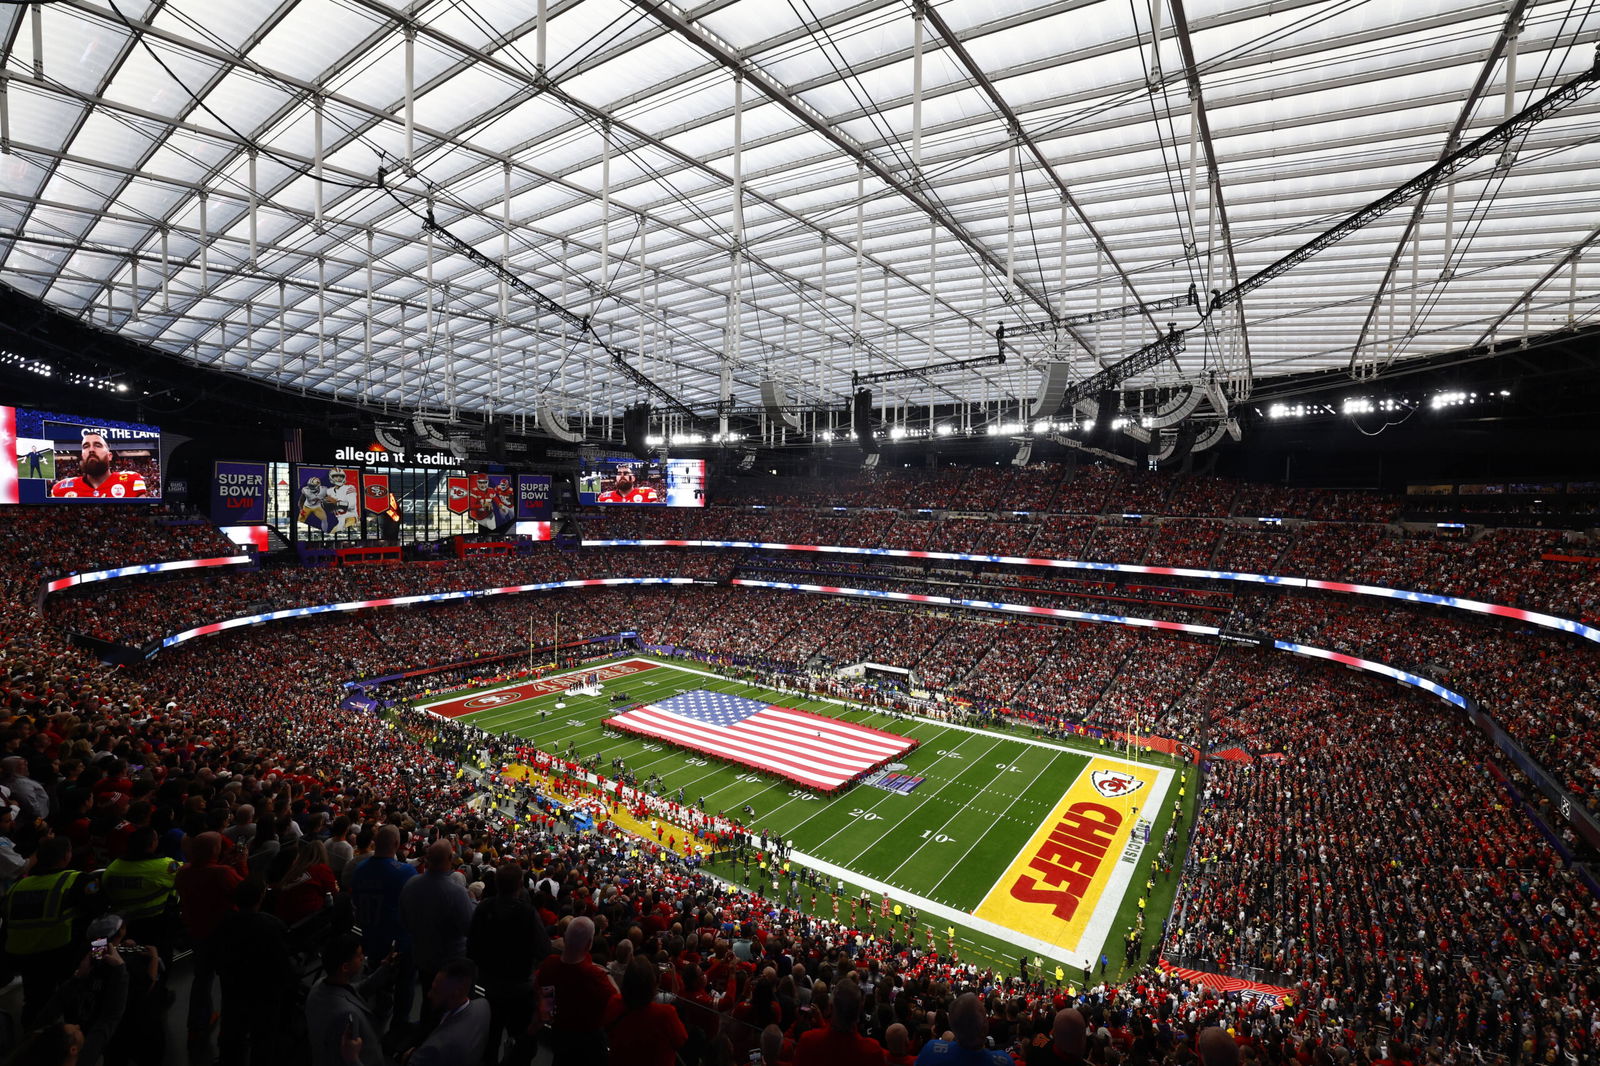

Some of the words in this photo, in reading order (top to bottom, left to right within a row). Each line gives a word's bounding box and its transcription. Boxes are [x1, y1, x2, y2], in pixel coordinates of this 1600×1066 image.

[110, 428, 131, 439] THE
[409, 452, 465, 466] tadiu
[218, 473, 263, 485] SUPER
[219, 485, 262, 497] BOWL
[520, 483, 550, 491] SUPER
[521, 492, 549, 500] BOWL
[685, 757, 708, 767] 50
[735, 773, 758, 783] 40
[788, 790, 814, 801] 30
[848, 808, 877, 821] 20
[919, 830, 949, 843] 10
[1010, 802, 1123, 922] CHIEFS
